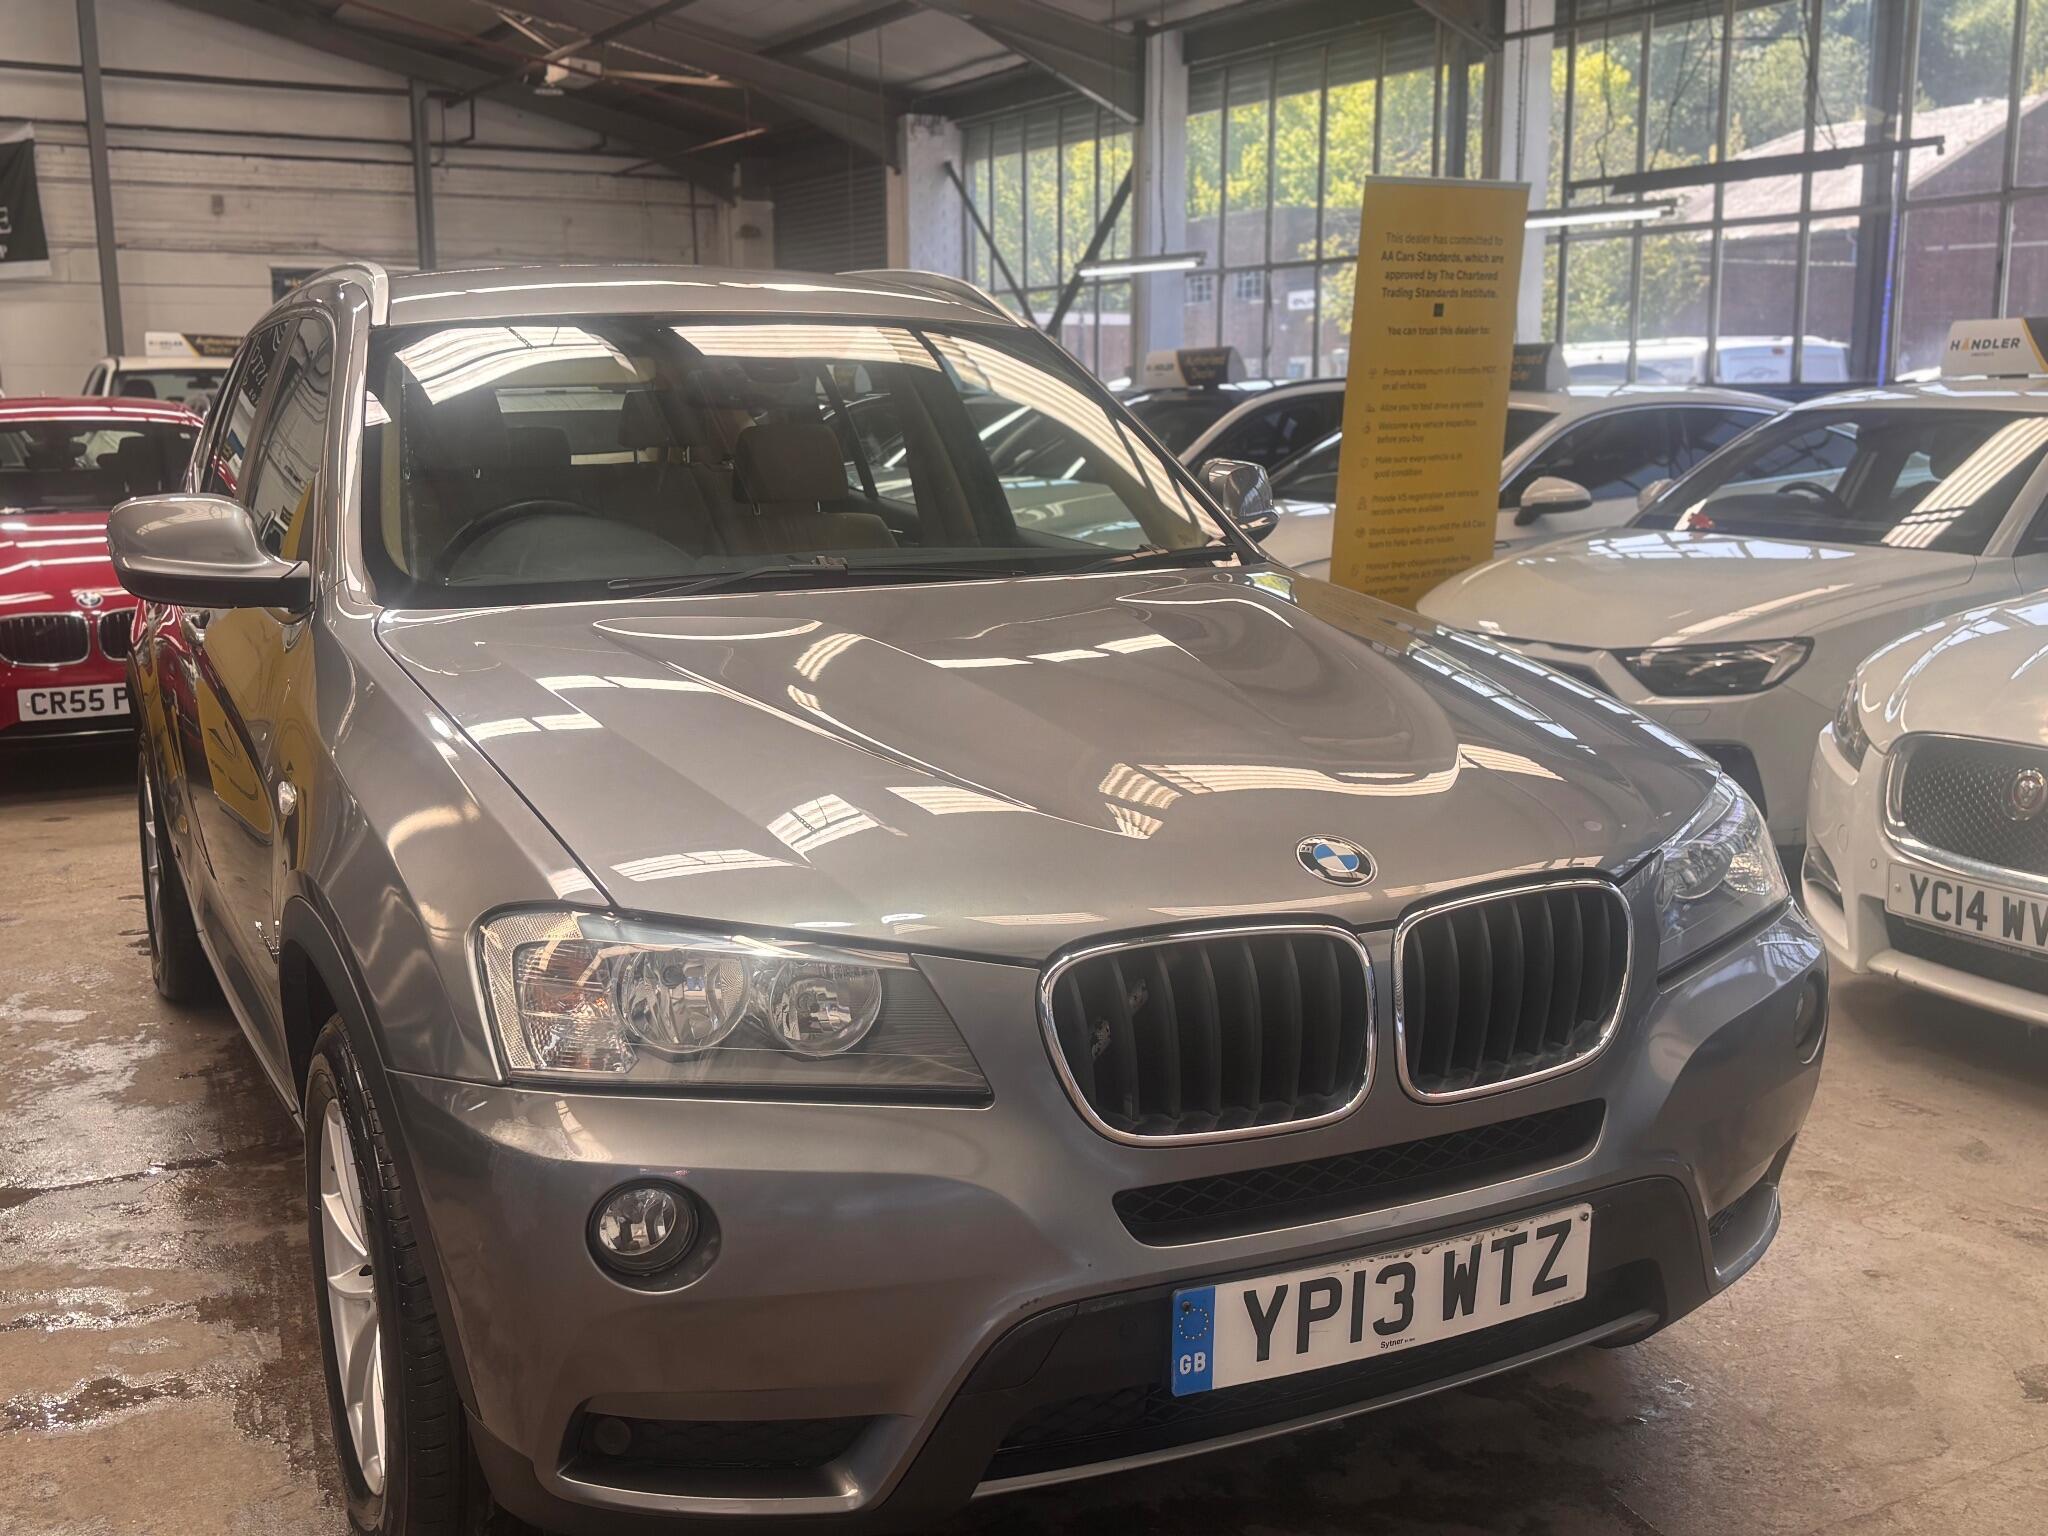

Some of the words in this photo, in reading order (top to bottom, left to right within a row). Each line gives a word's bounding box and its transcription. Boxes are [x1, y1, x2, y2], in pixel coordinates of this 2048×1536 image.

[1386, 232, 1403, 244] This
[1405, 233, 1431, 244] dealer
[1433, 235, 1447, 244] has
[1381, 251, 1393, 261] AA
[1396, 251, 1415, 261] Cars
[1464, 253, 1489, 263] which
[1385, 270, 1424, 281] approved
[1427, 270, 1437, 281] by
[1440, 270, 1454, 280] The
[1456, 270, 1498, 280] Chartered
[1382, 287, 1413, 300] Trading
[1415, 288, 1458, 297] Standards
[1419, 327, 1437, 335] trust
[1455, 326, 1479, 335] dealer
[30, 689, 105, 716] CR55
[1909, 873, 1988, 931] YC14
[1243, 1261, 1416, 1362] YP13
[1442, 1219, 1572, 1321] WTZ
[1380, 1338, 1404, 1349] Sytner
[1179, 1351, 1206, 1375] GB
